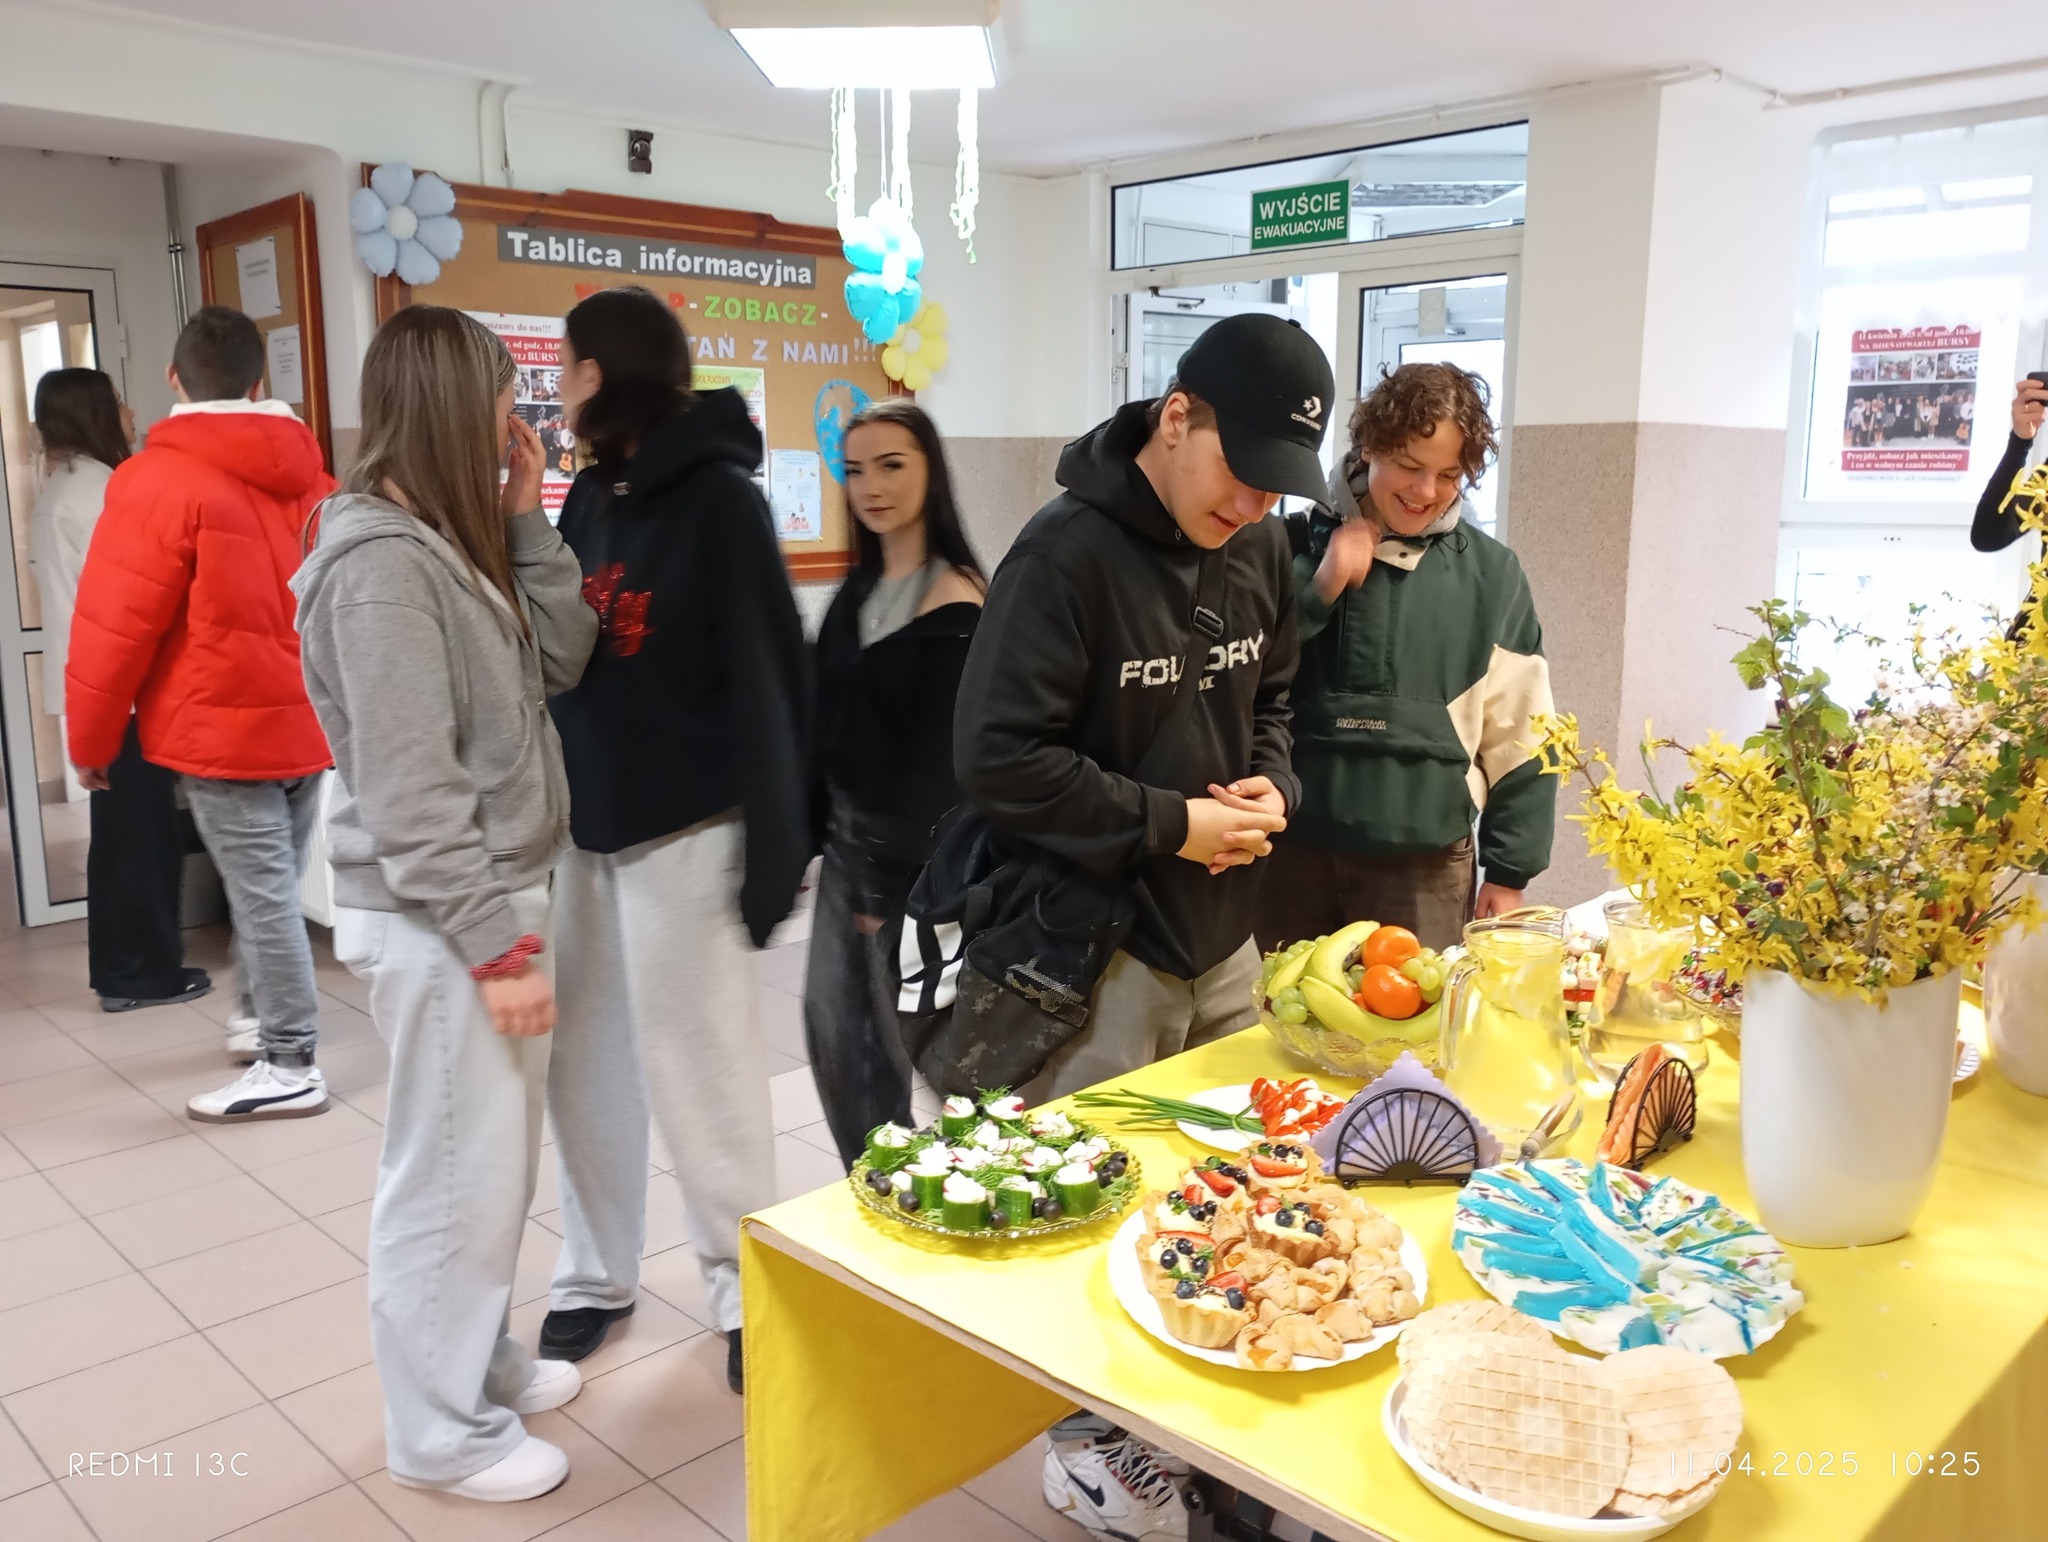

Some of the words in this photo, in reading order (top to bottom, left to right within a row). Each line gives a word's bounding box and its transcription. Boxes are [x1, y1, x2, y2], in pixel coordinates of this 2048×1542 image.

[1260, 192, 1341, 220] WYJŚCIE
[1254, 216, 1345, 240] EWAKUACYJNE
[507, 231, 622, 268] Tablica
[640, 245, 812, 288] informacyjna
[517, 323, 526, 331] do
[523, 341, 543, 350] godz.
[1937, 336, 1972, 347] BURSY
[528, 352, 559, 362] BURSY
[752, 339, 768, 361] Z
